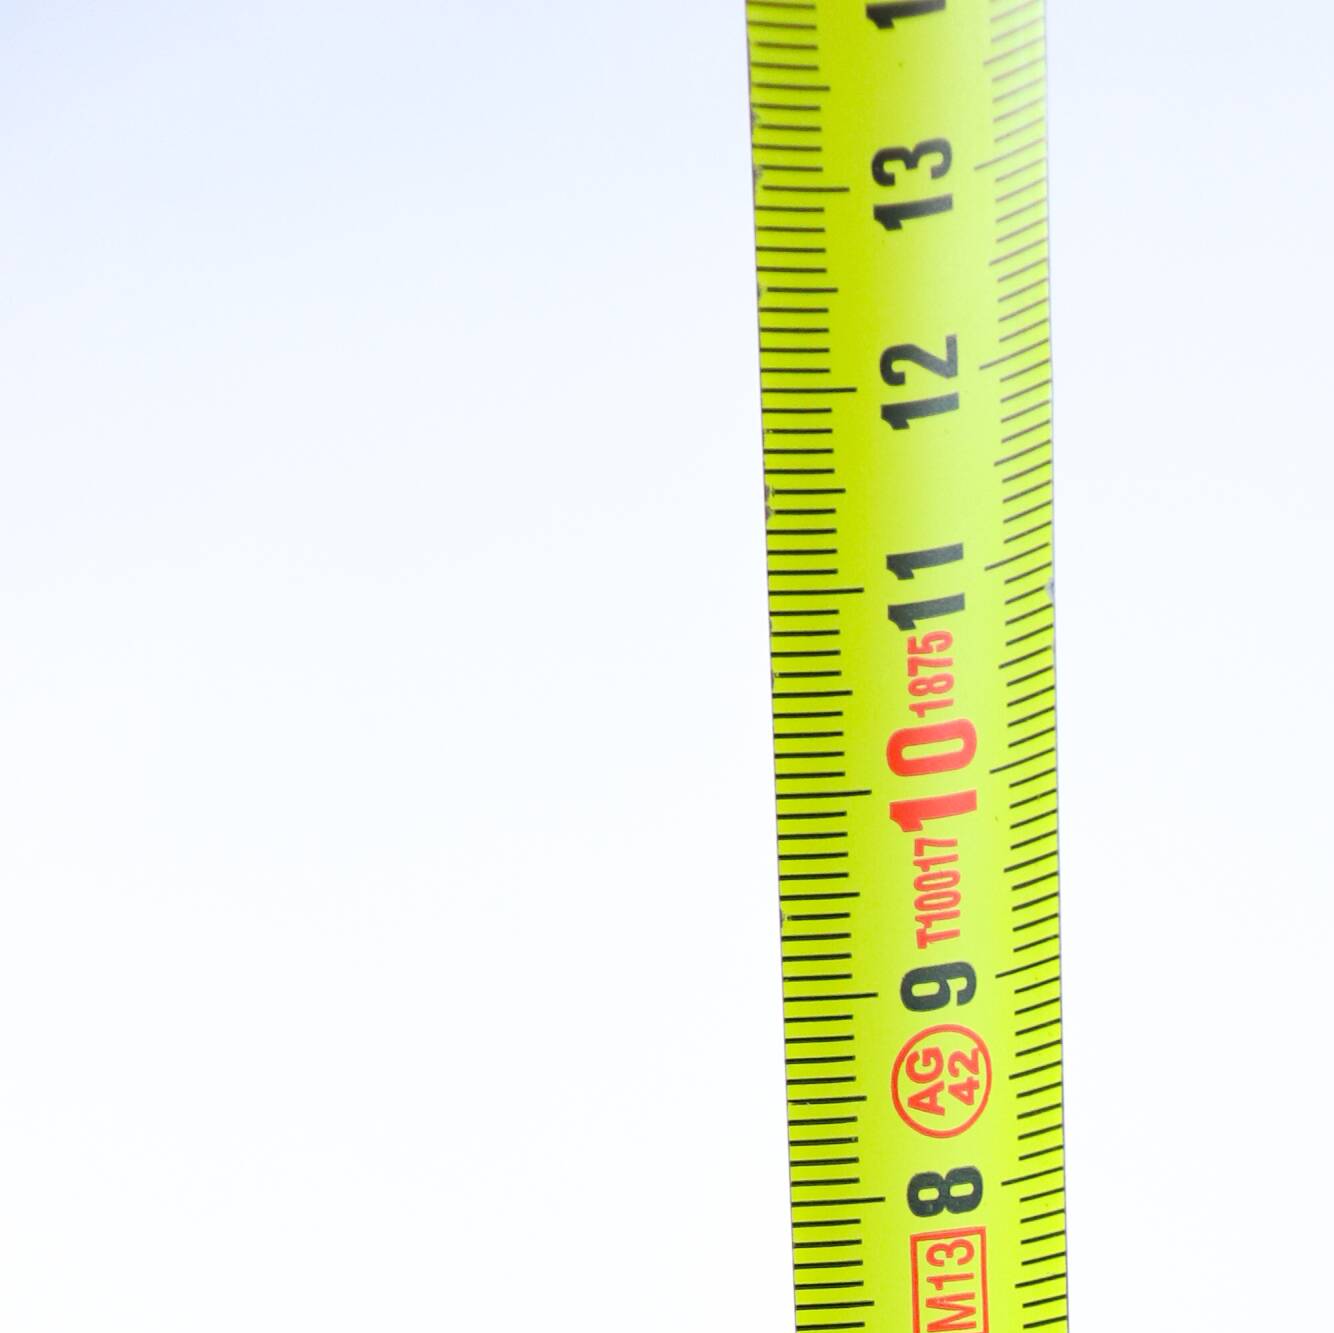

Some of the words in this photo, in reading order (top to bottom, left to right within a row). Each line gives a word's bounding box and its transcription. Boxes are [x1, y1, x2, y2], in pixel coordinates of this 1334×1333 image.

[866, 0, 944, 29] 1
[871, 137, 953, 231] 13
[879, 333, 960, 431] 12
[886, 543, 966, 632] 11
[907, 631, 954, 716] 1875
[886, 720, 976, 832] 10
[913, 838, 960, 949] T10017
[900, 961, 976, 1012] 9
[904, 1046, 946, 1116] AG
[946, 1048, 982, 1106] 42
[906, 1165, 983, 1218] 8
[925, 1238, 976, 1333] M13
